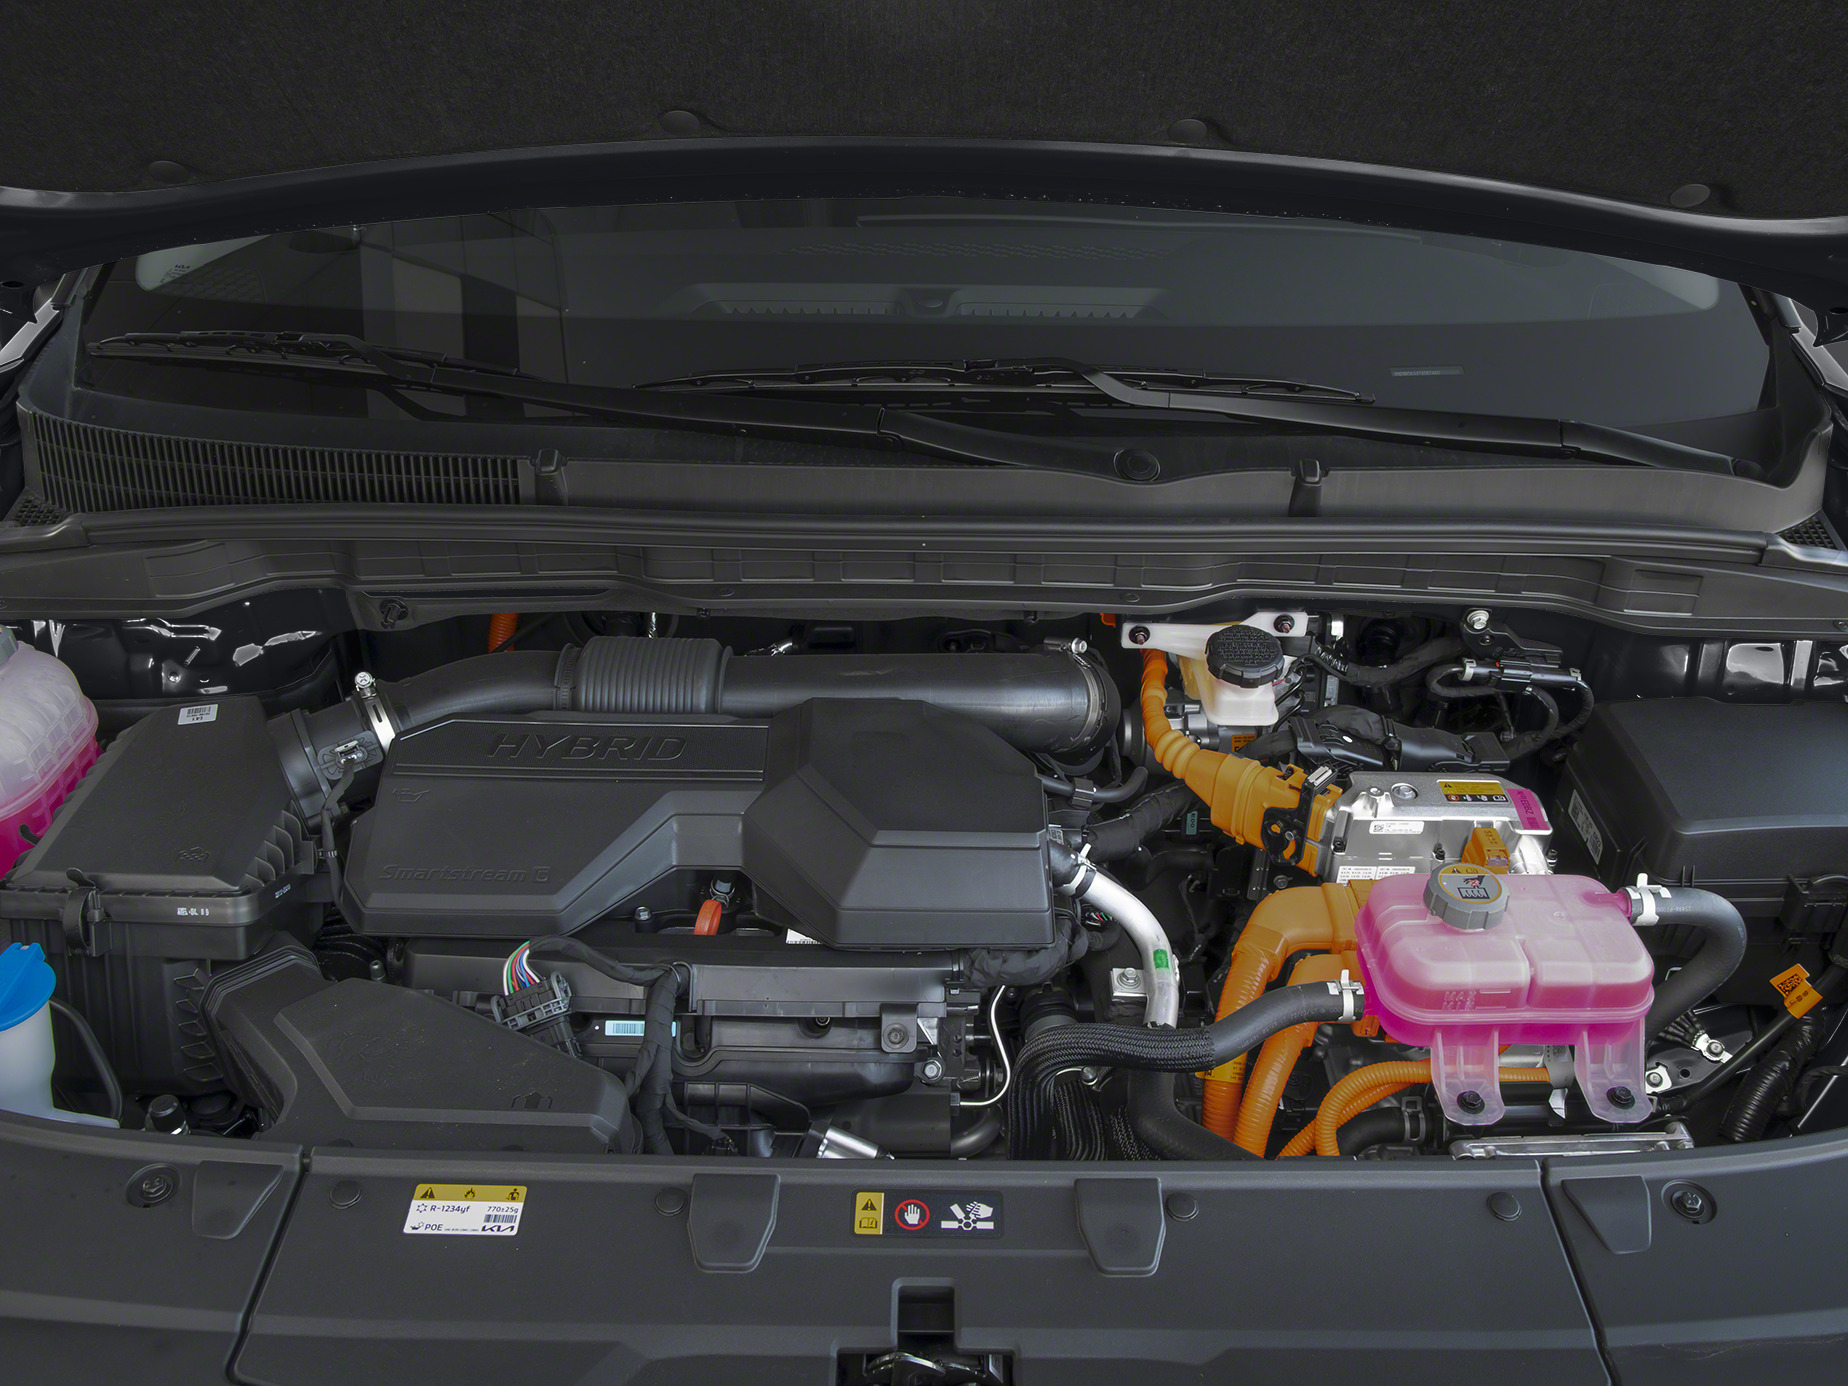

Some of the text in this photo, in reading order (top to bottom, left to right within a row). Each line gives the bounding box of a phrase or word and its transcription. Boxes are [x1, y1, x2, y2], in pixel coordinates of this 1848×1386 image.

[487, 734, 688, 760] HYBRID
[379, 864, 528, 882] Smartstream
[430, 1204, 519, 1214] R-1234yf 770±25g
[424, 1223, 444, 1231] POE
[481, 1224, 515, 1232] KIA
